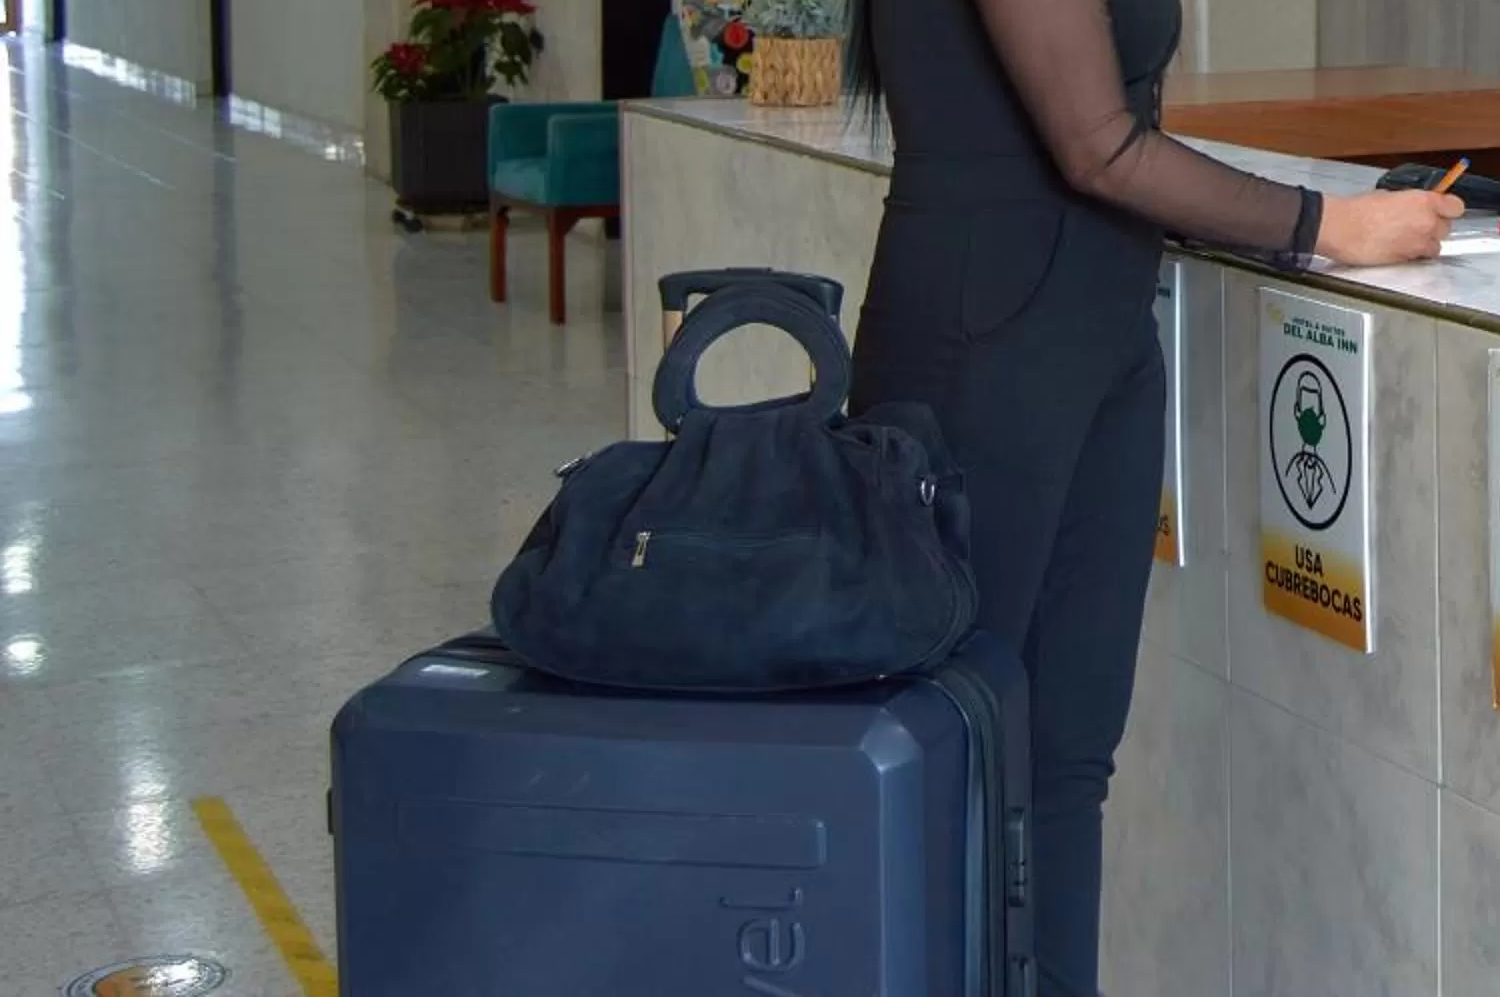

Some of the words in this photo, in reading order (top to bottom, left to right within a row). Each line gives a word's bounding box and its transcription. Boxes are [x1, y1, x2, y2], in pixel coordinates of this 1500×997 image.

[1283, 322, 1304, 340] DEL
[1305, 329, 1335, 347] ALBA
[1337, 337, 1358, 354] INN
[1295, 544, 1324, 577] USA
[1265, 560, 1363, 622] CUBREBOCAS
